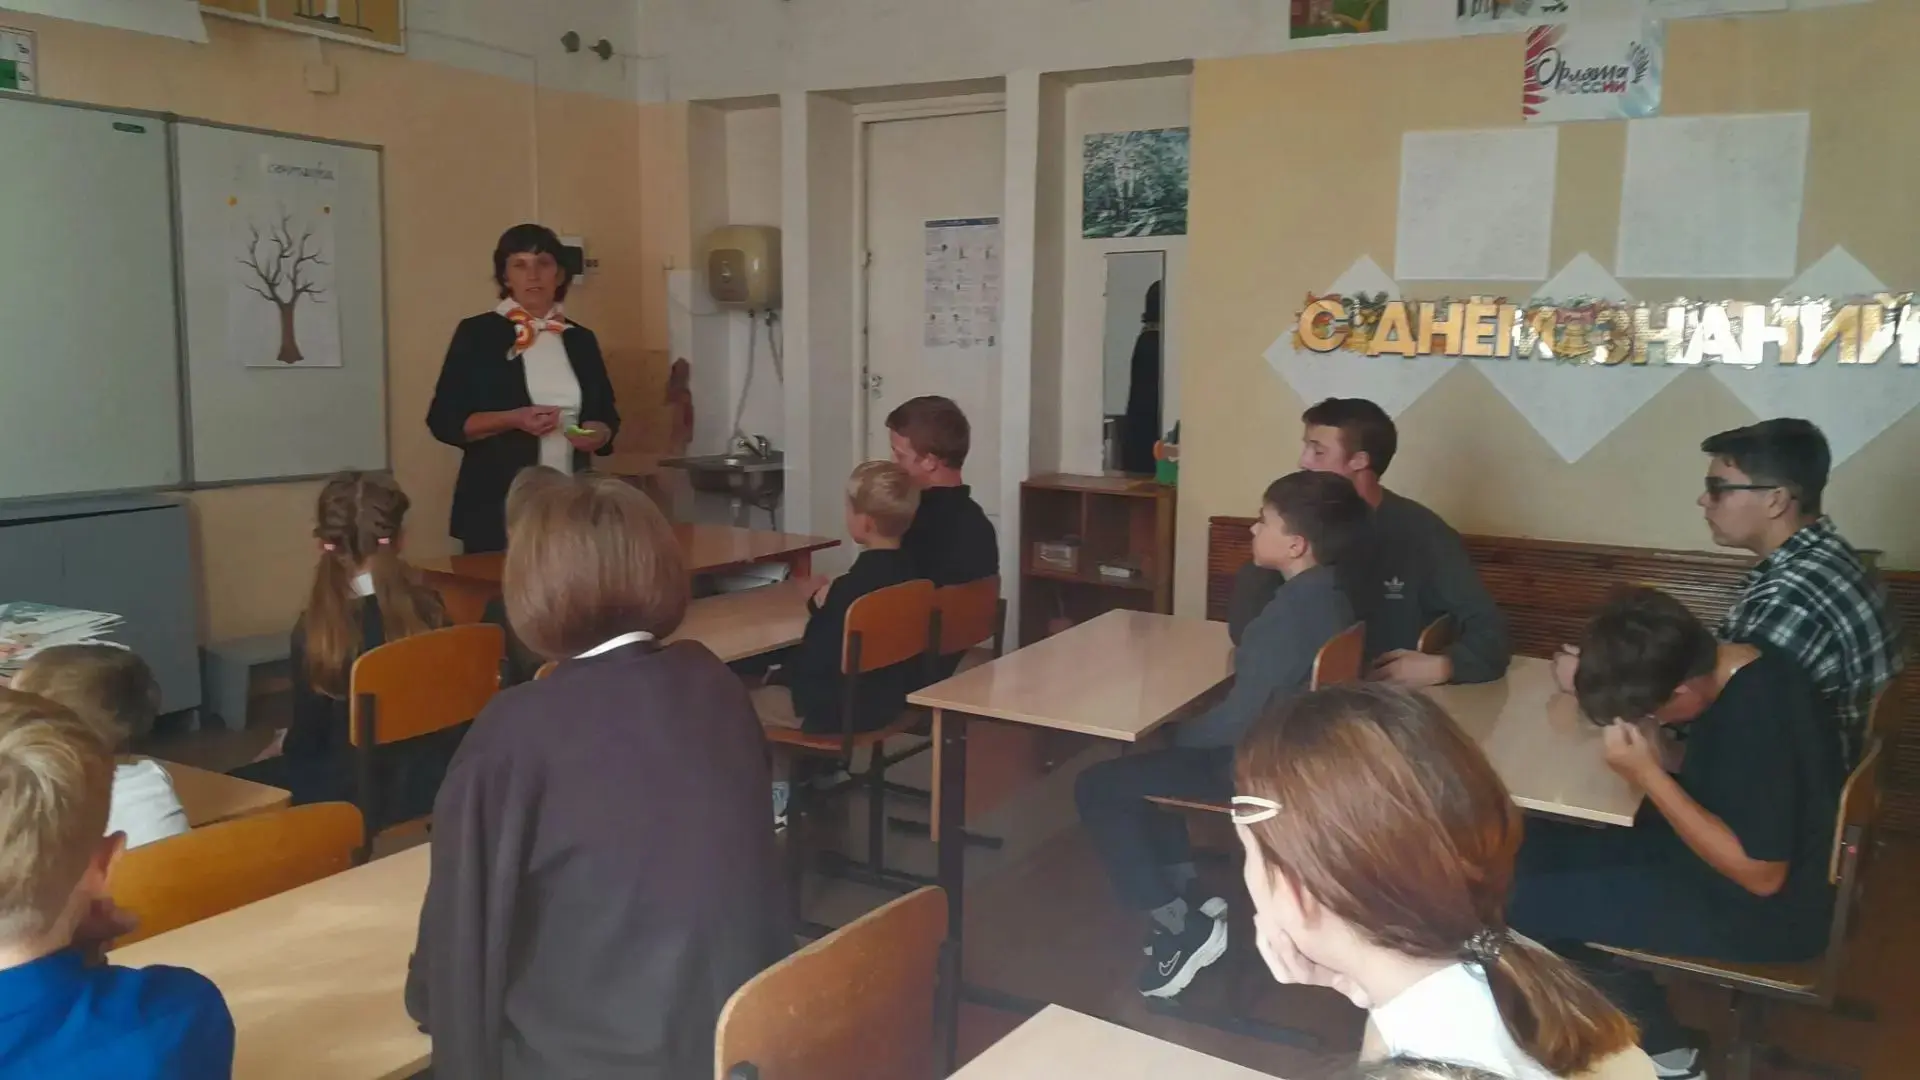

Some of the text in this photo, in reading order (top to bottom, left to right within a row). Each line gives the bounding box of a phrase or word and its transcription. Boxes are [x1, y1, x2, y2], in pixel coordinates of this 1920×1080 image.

[1536, 47, 1629, 87] Орлята
[1557, 80, 1627, 95] РОССИИ
[1299, 299, 1350, 353] С
[1367, 295, 1557, 359] ДНЁМ
